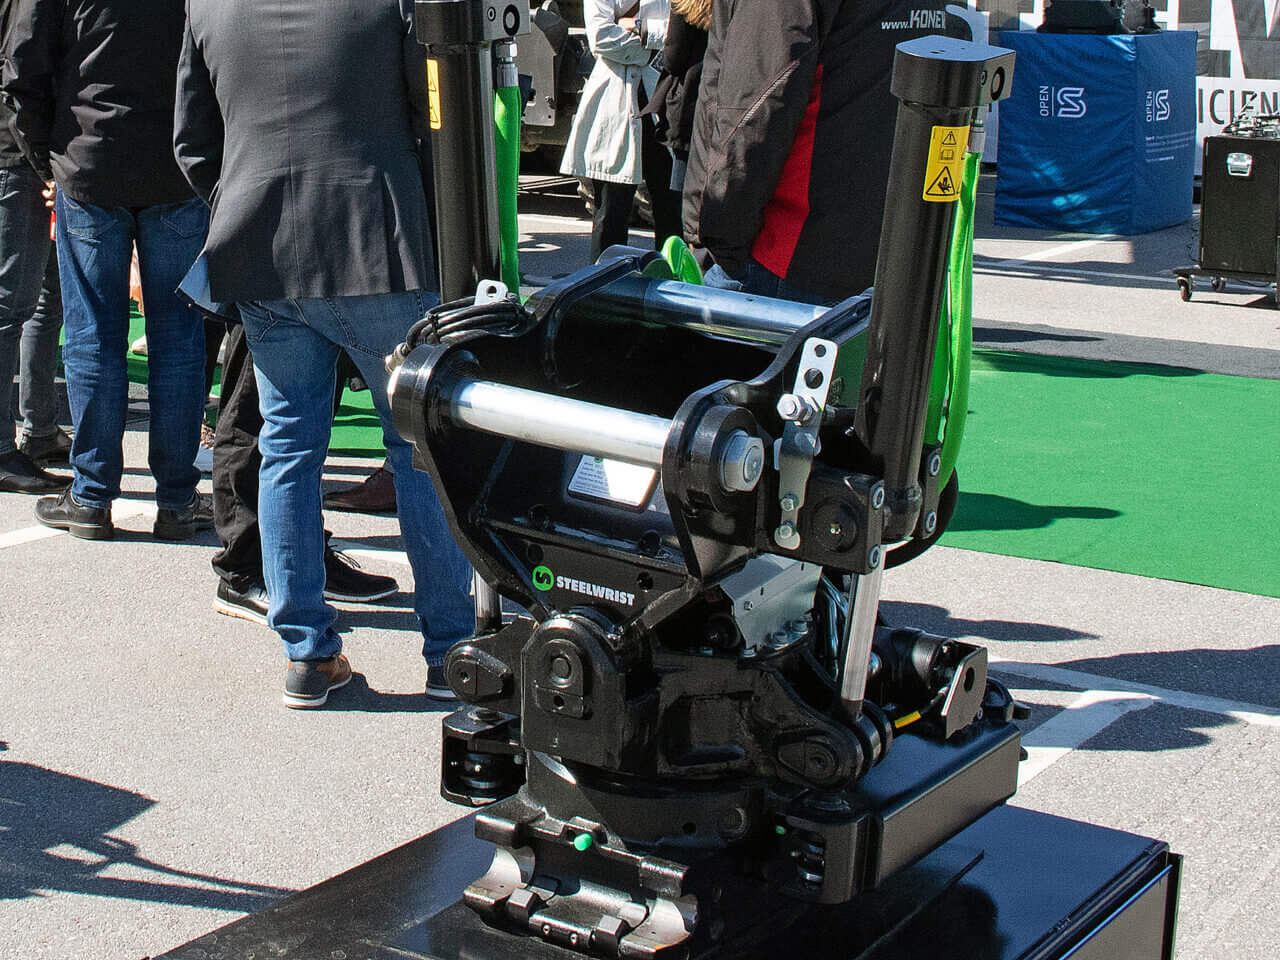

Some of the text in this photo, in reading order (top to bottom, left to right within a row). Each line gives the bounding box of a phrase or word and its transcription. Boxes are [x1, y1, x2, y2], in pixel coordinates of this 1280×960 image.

[1039, 85, 1049, 117] OPEN
[1145, 90, 1153, 122] OPEN
[556, 575, 635, 606] STEELWRIST
